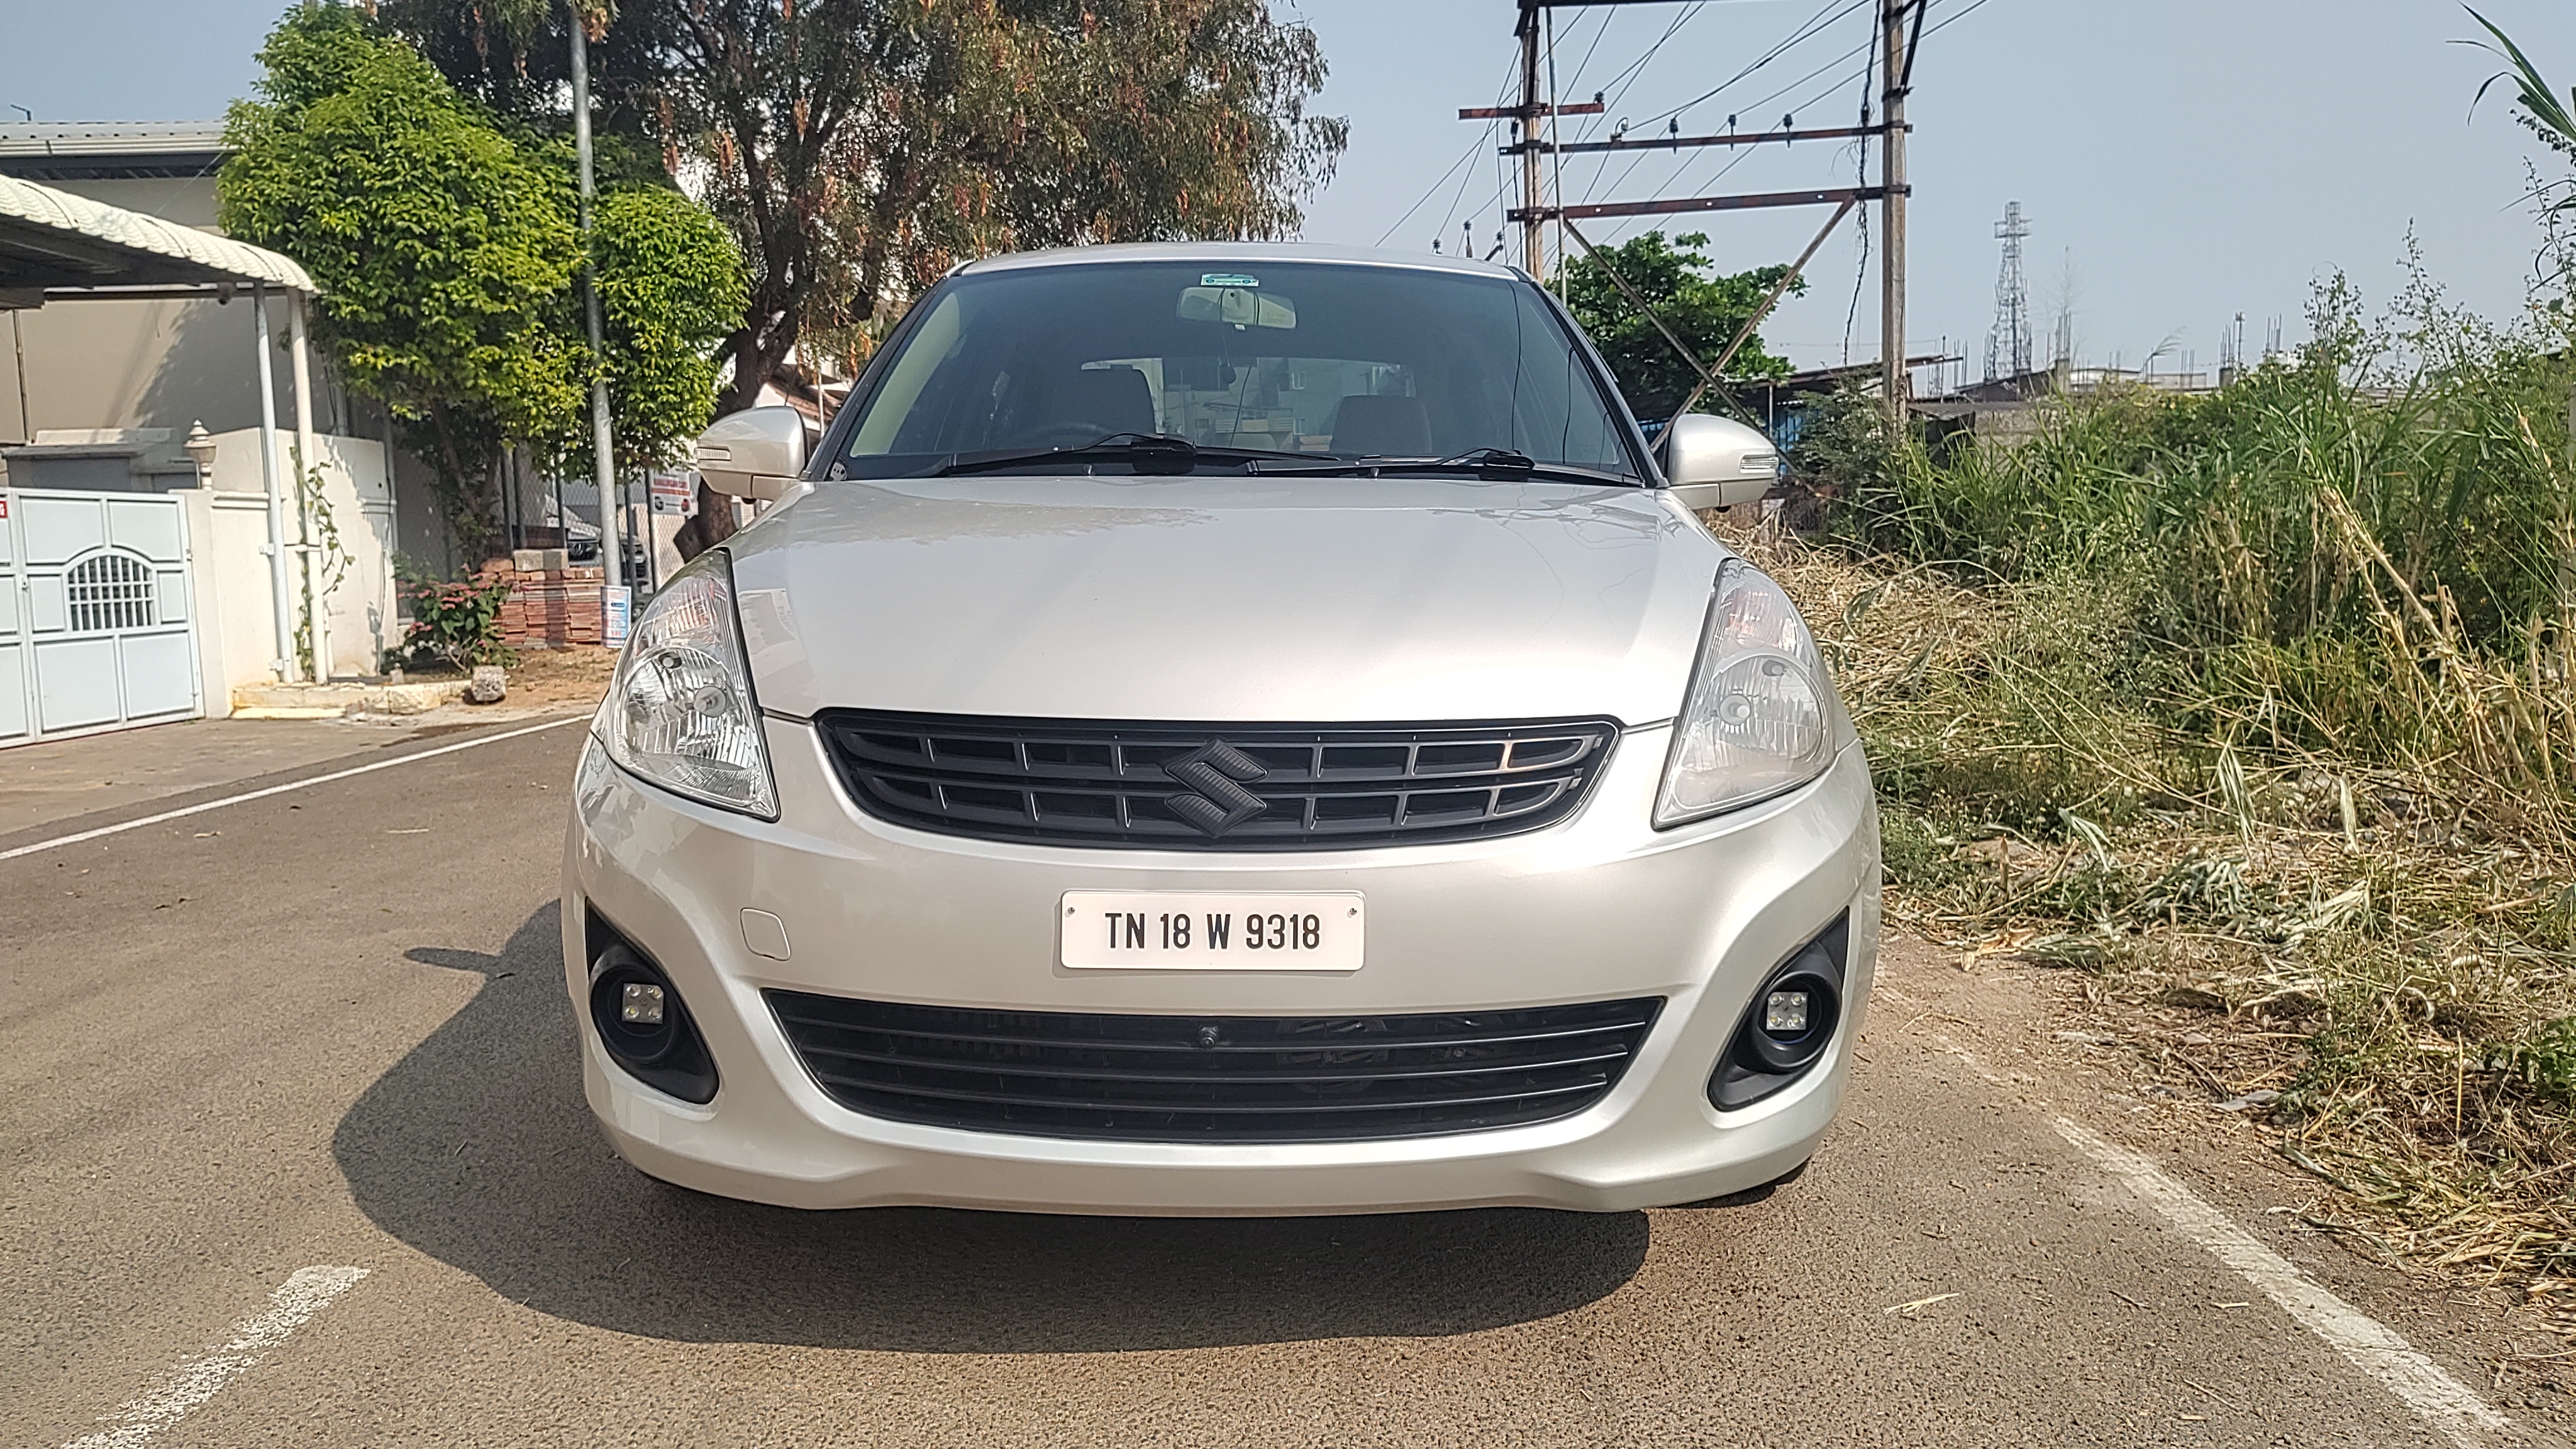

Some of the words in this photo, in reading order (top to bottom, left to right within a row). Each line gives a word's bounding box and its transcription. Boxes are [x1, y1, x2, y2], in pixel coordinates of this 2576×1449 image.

[1105, 913, 1145, 949] TN
[1160, 913, 1191, 949] 18
[1206, 914, 1231, 950] W
[1246, 914, 1319, 950] 9318
